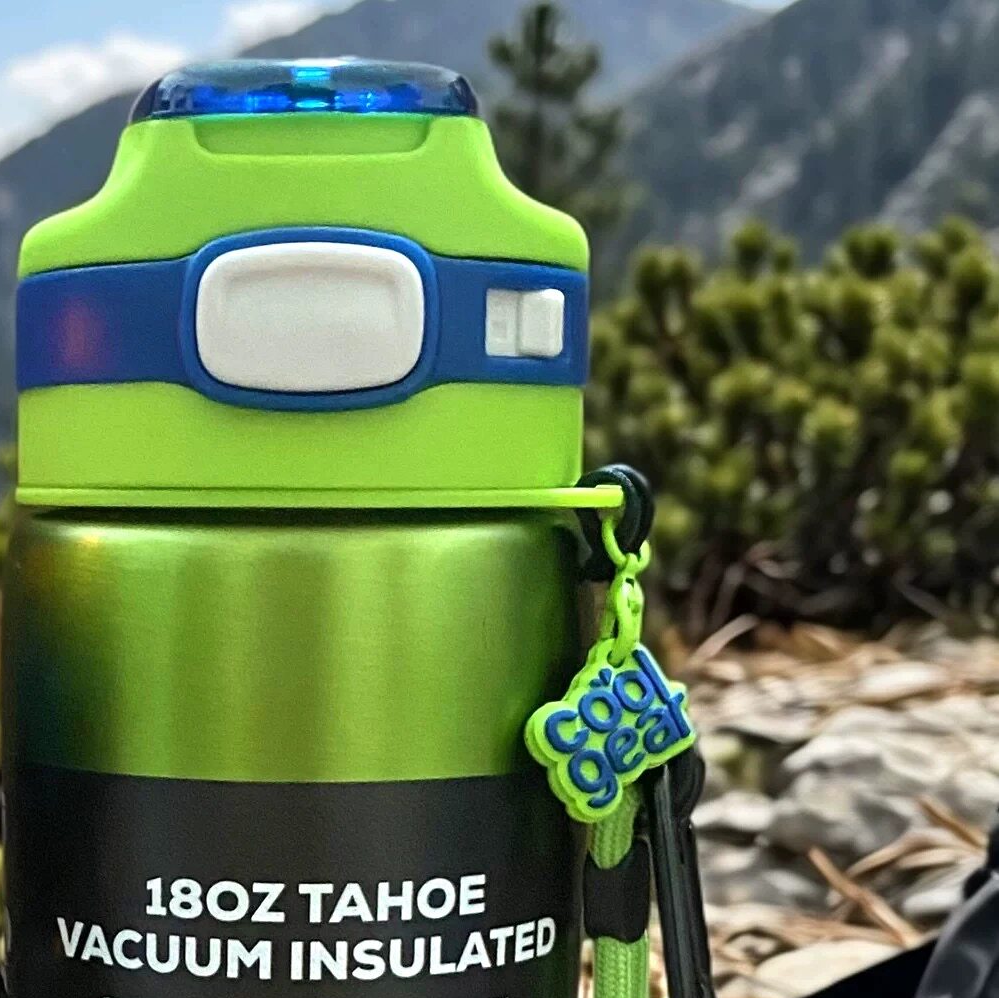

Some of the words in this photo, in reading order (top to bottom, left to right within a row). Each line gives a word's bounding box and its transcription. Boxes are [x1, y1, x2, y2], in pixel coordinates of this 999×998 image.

[545, 650, 671, 754] cool
[568, 692, 691, 808] gear
[145, 877, 286, 923] 18OZ
[298, 873, 486, 924] TAHOE
[56, 916, 272, 980] VACUUM
[290, 916, 557, 982] INSULATED
